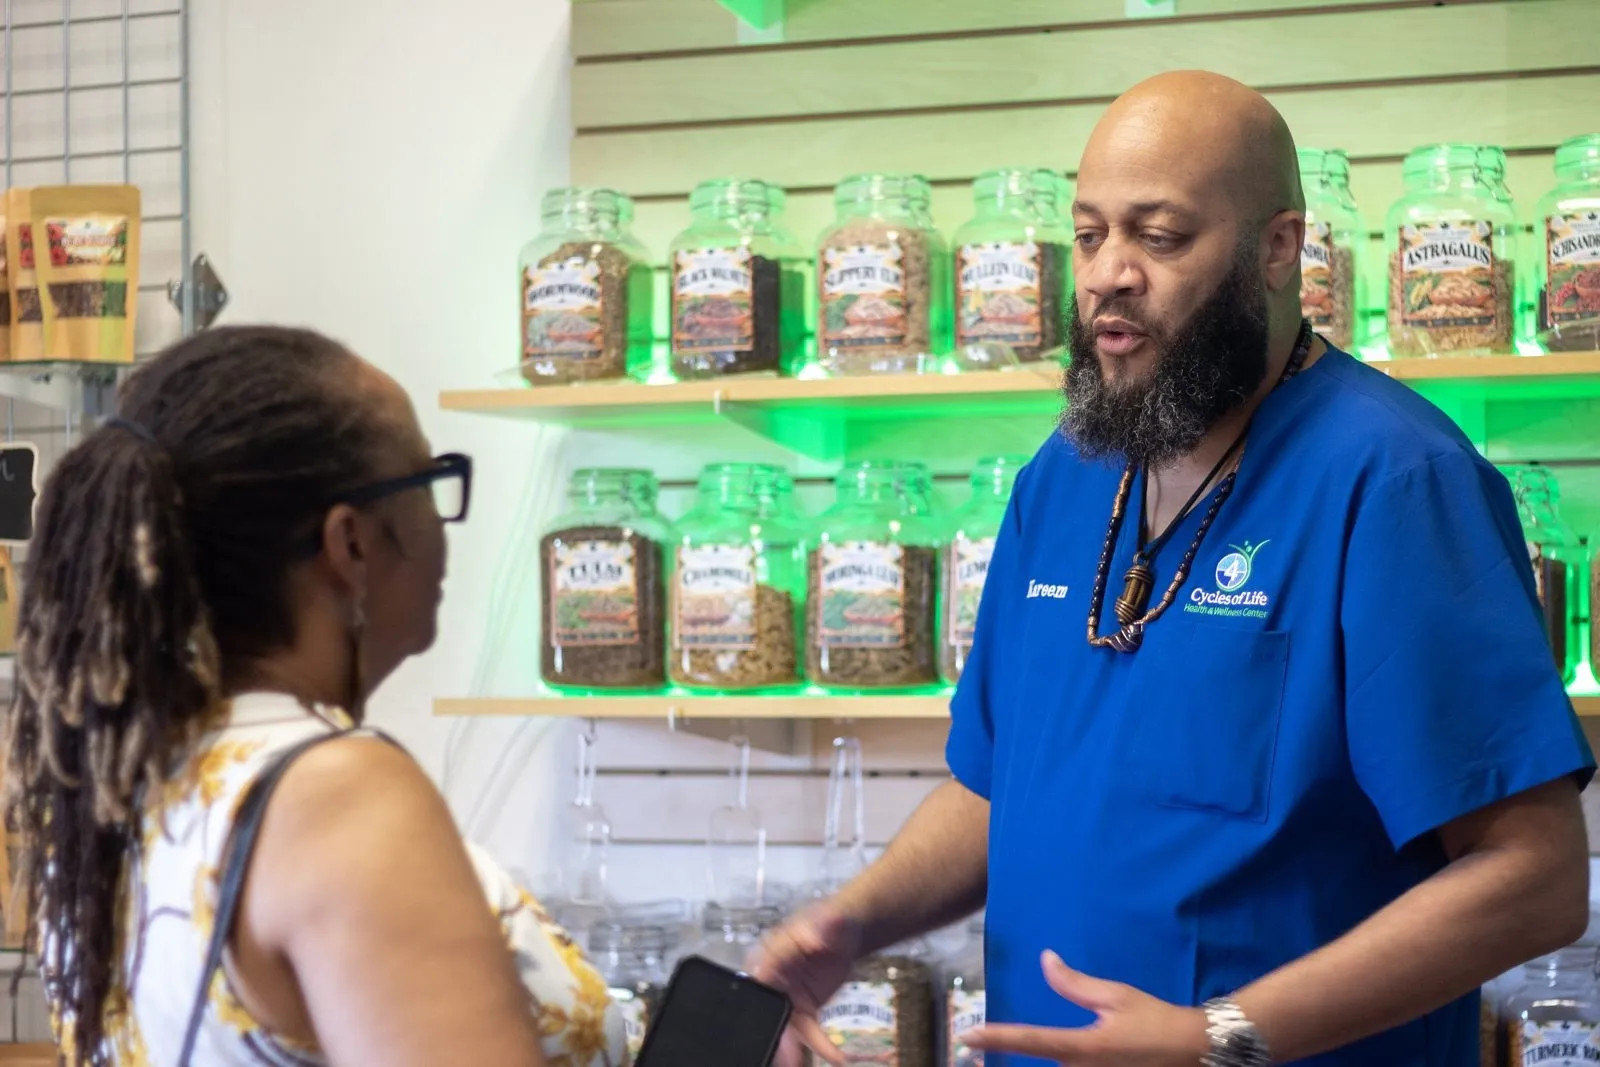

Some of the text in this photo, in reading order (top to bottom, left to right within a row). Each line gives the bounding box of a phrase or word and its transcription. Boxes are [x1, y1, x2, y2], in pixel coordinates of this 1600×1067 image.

[1408, 242, 1489, 265] ASTRAGALUS
[679, 267, 750, 290] BLACK WALNUT
[826, 266, 900, 287] SLIPPERY ELM
[962, 262, 1009, 284] MULLEIN
[826, 564, 873, 585] MORINGA
[1190, 587, 1268, 606] Cycles of Life
[1184, 603, 1208, 614] Health
[1213, 606, 1242, 617] Wellness
[1242, 608, 1268, 618] Center
[1526, 1043, 1577, 1064] TURMERIC
